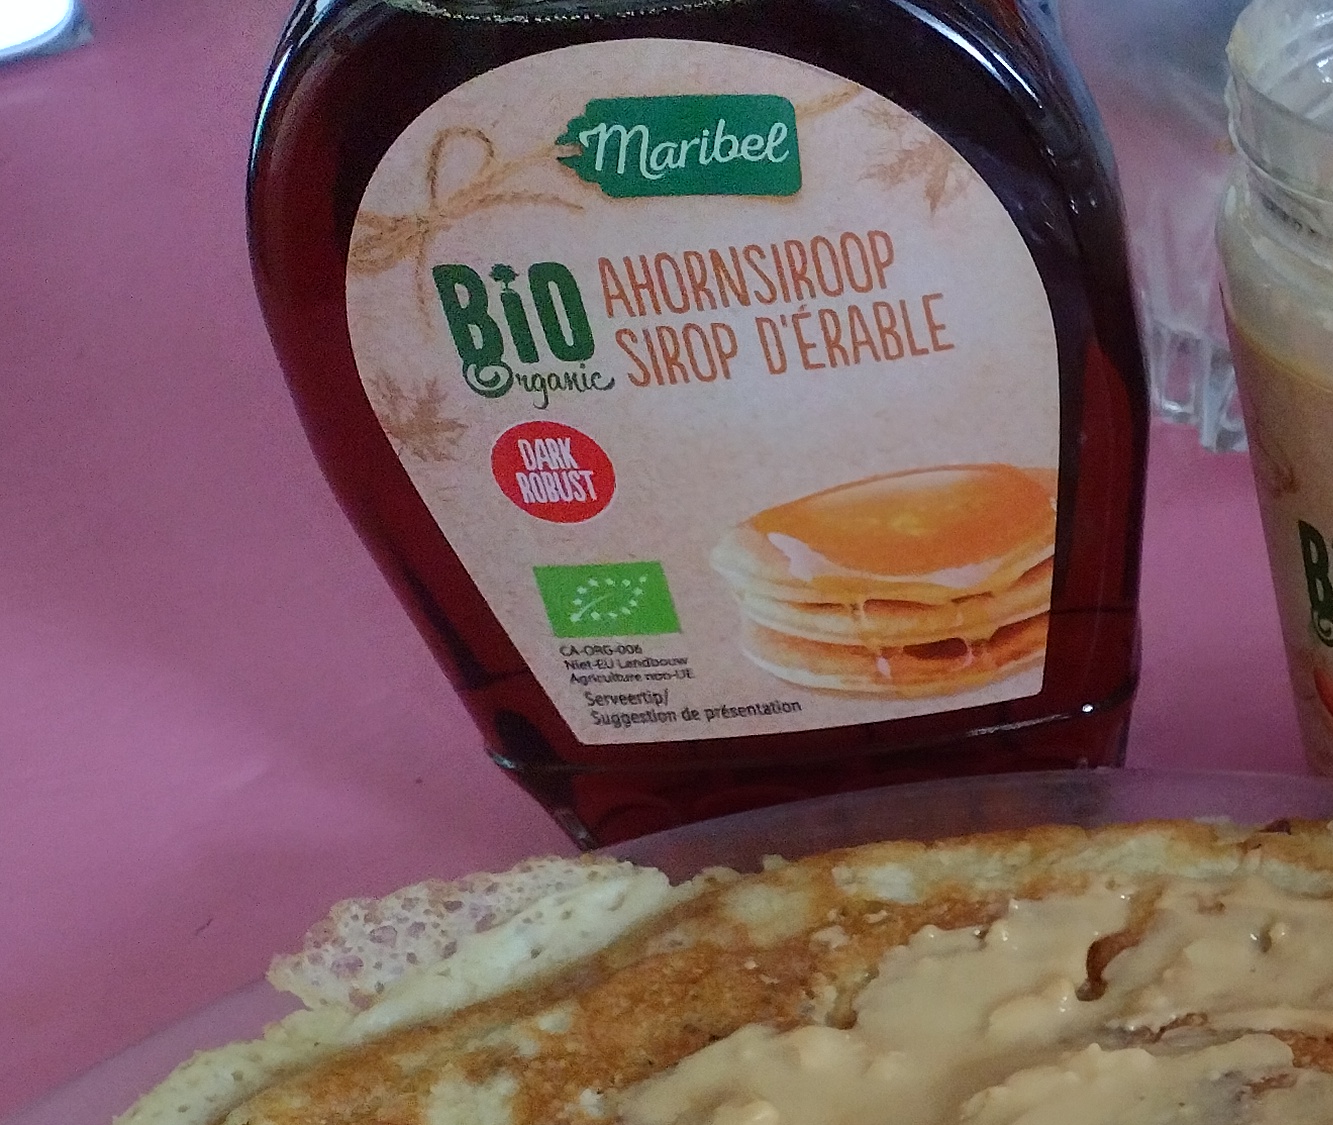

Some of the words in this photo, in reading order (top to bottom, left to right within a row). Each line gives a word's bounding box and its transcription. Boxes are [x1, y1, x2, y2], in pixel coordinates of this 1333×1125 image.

[578, 117, 791, 181] Maribel
[597, 229, 896, 319] AHORNSIROOP
[614, 321, 739, 389] SIROP
[755, 293, 956, 376] D'ÉRABLE
[517, 437, 579, 471] DARK
[515, 470, 598, 504] ROBUST
[564, 659, 615, 671] Niet-EU
[618, 657, 689, 669] Landbouw
[569, 672, 643, 686] Agriculture
[584, 689, 669, 708] Serveertip/
[590, 708, 677, 729] Suggestion
[681, 706, 700, 723] de
[703, 700, 803, 723] présentation
